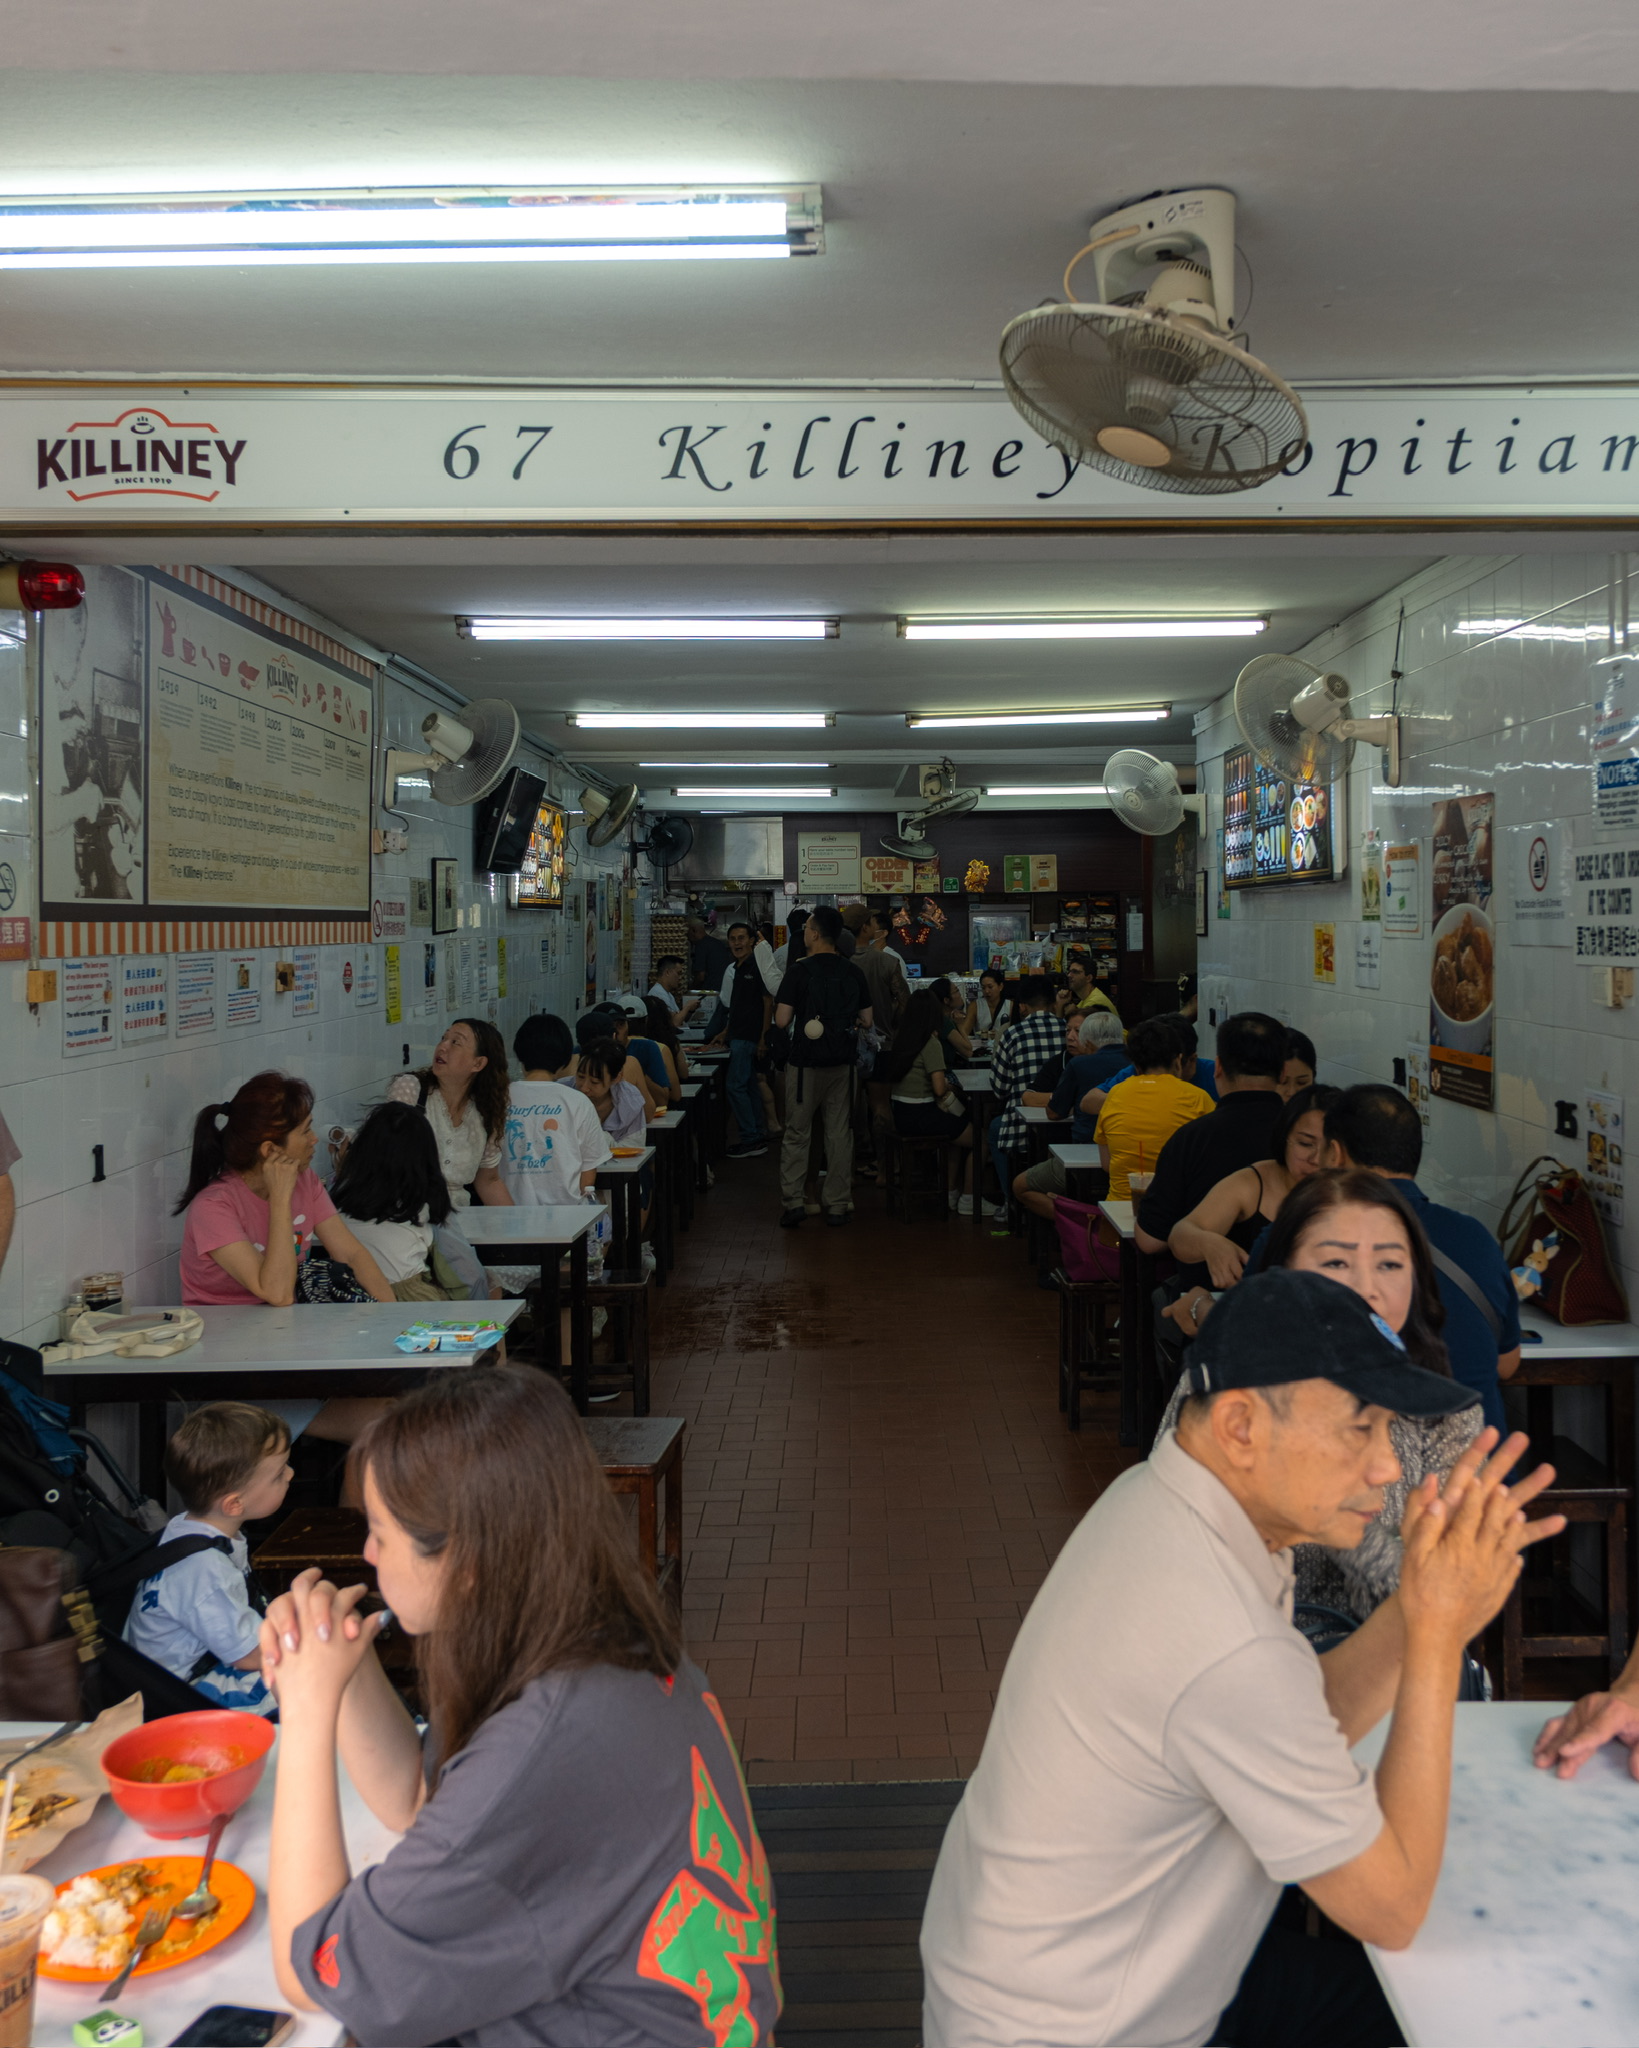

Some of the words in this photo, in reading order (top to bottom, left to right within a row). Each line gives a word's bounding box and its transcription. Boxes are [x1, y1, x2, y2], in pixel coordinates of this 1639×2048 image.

[37, 438, 248, 490] KILLINEY
[658, 416, 1086, 499] Killiney
[114, 476, 147, 486] SINCE
[149, 476, 173, 486] 1919
[160, 679, 180, 697] 1919
[266, 663, 299, 699] KILLINEY
[200, 693, 218, 710] 1992
[169, 844, 201, 863] Experience
[801, 848, 805, 857] 1
[801, 864, 807, 874] 2
[865, 858, 909, 871] ORDER
[1575, 855, 1593, 881] PLEASE
[1595, 853, 1610, 880] PLACE
[872, 871, 903, 883] HERE
[507, 1104, 537, 1118] Surf
[534, 1104, 562, 1116] Club
[1554, 1100, 1578, 1139] 15
[92, 1144, 106, 1183] 1
